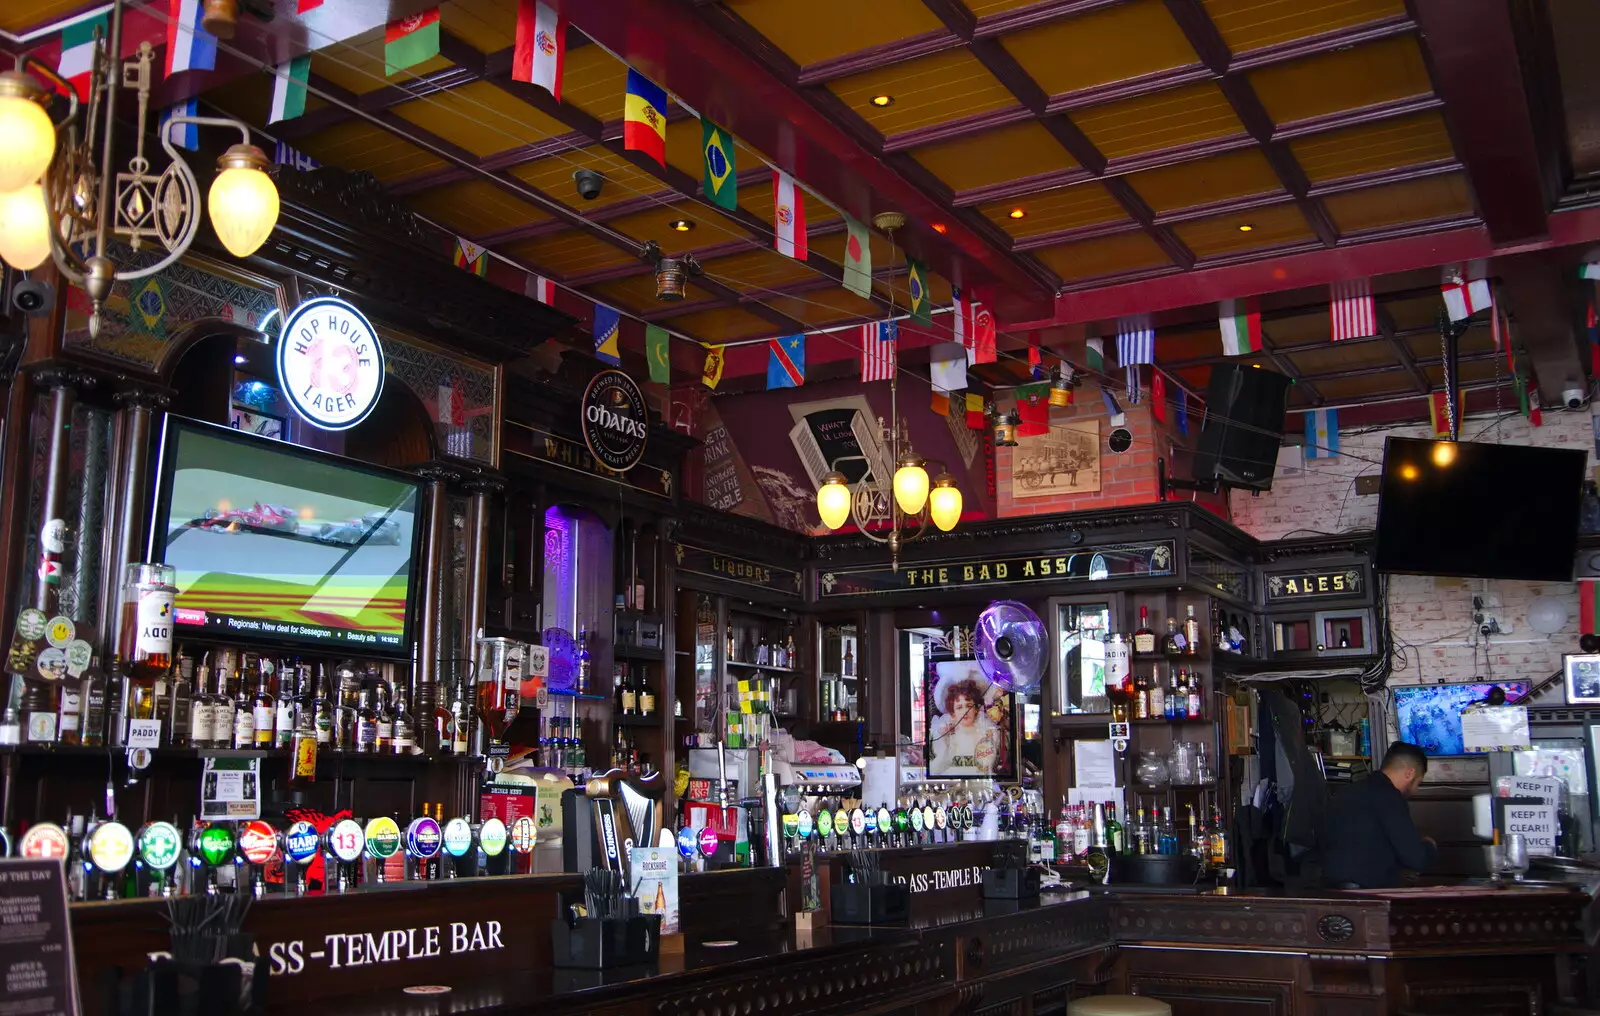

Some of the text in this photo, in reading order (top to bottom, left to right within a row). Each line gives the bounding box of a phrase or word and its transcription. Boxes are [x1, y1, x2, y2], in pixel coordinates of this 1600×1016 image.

[294, 315, 371, 367] HOP HOUSE
[303, 384, 356, 412] LAGER
[591, 376, 613, 399] BREWED
[623, 380, 643, 416] IRELAND
[714, 427, 727, 440] TO
[816, 419, 846, 432] WHAT
[589, 429, 641, 464] IRISH CRAFT BEERS
[723, 475, 740, 492] THE
[710, 488, 743, 510] TABLE
[713, 557, 770, 582] LIQUORS
[907, 557, 1067, 586] THE BAD ASS
[1285, 575, 1345, 594] ALES
[228, 617, 331, 638] Regionals: New deal for Sessegnon
[347, 631, 376, 643] Beauty sits
[132, 728, 159, 738] PADDY
[690, 789, 708, 799] ASS
[1516, 781, 1553, 793] KEEP IT
[1511, 810, 1547, 819] KEEP IT
[602, 813, 616, 859] GUINNESS
[1510, 824, 1549, 833] CLEAR!!
[290, 834, 318, 849] HARP
[336, 833, 356, 850] 13
[1523, 838, 1550, 846] RVICE
[9, 871, 30, 882] THE
[31, 870, 51, 880] DAY
[0, 894, 40, 905] raditional
[449, 920, 504, 954] BAR
